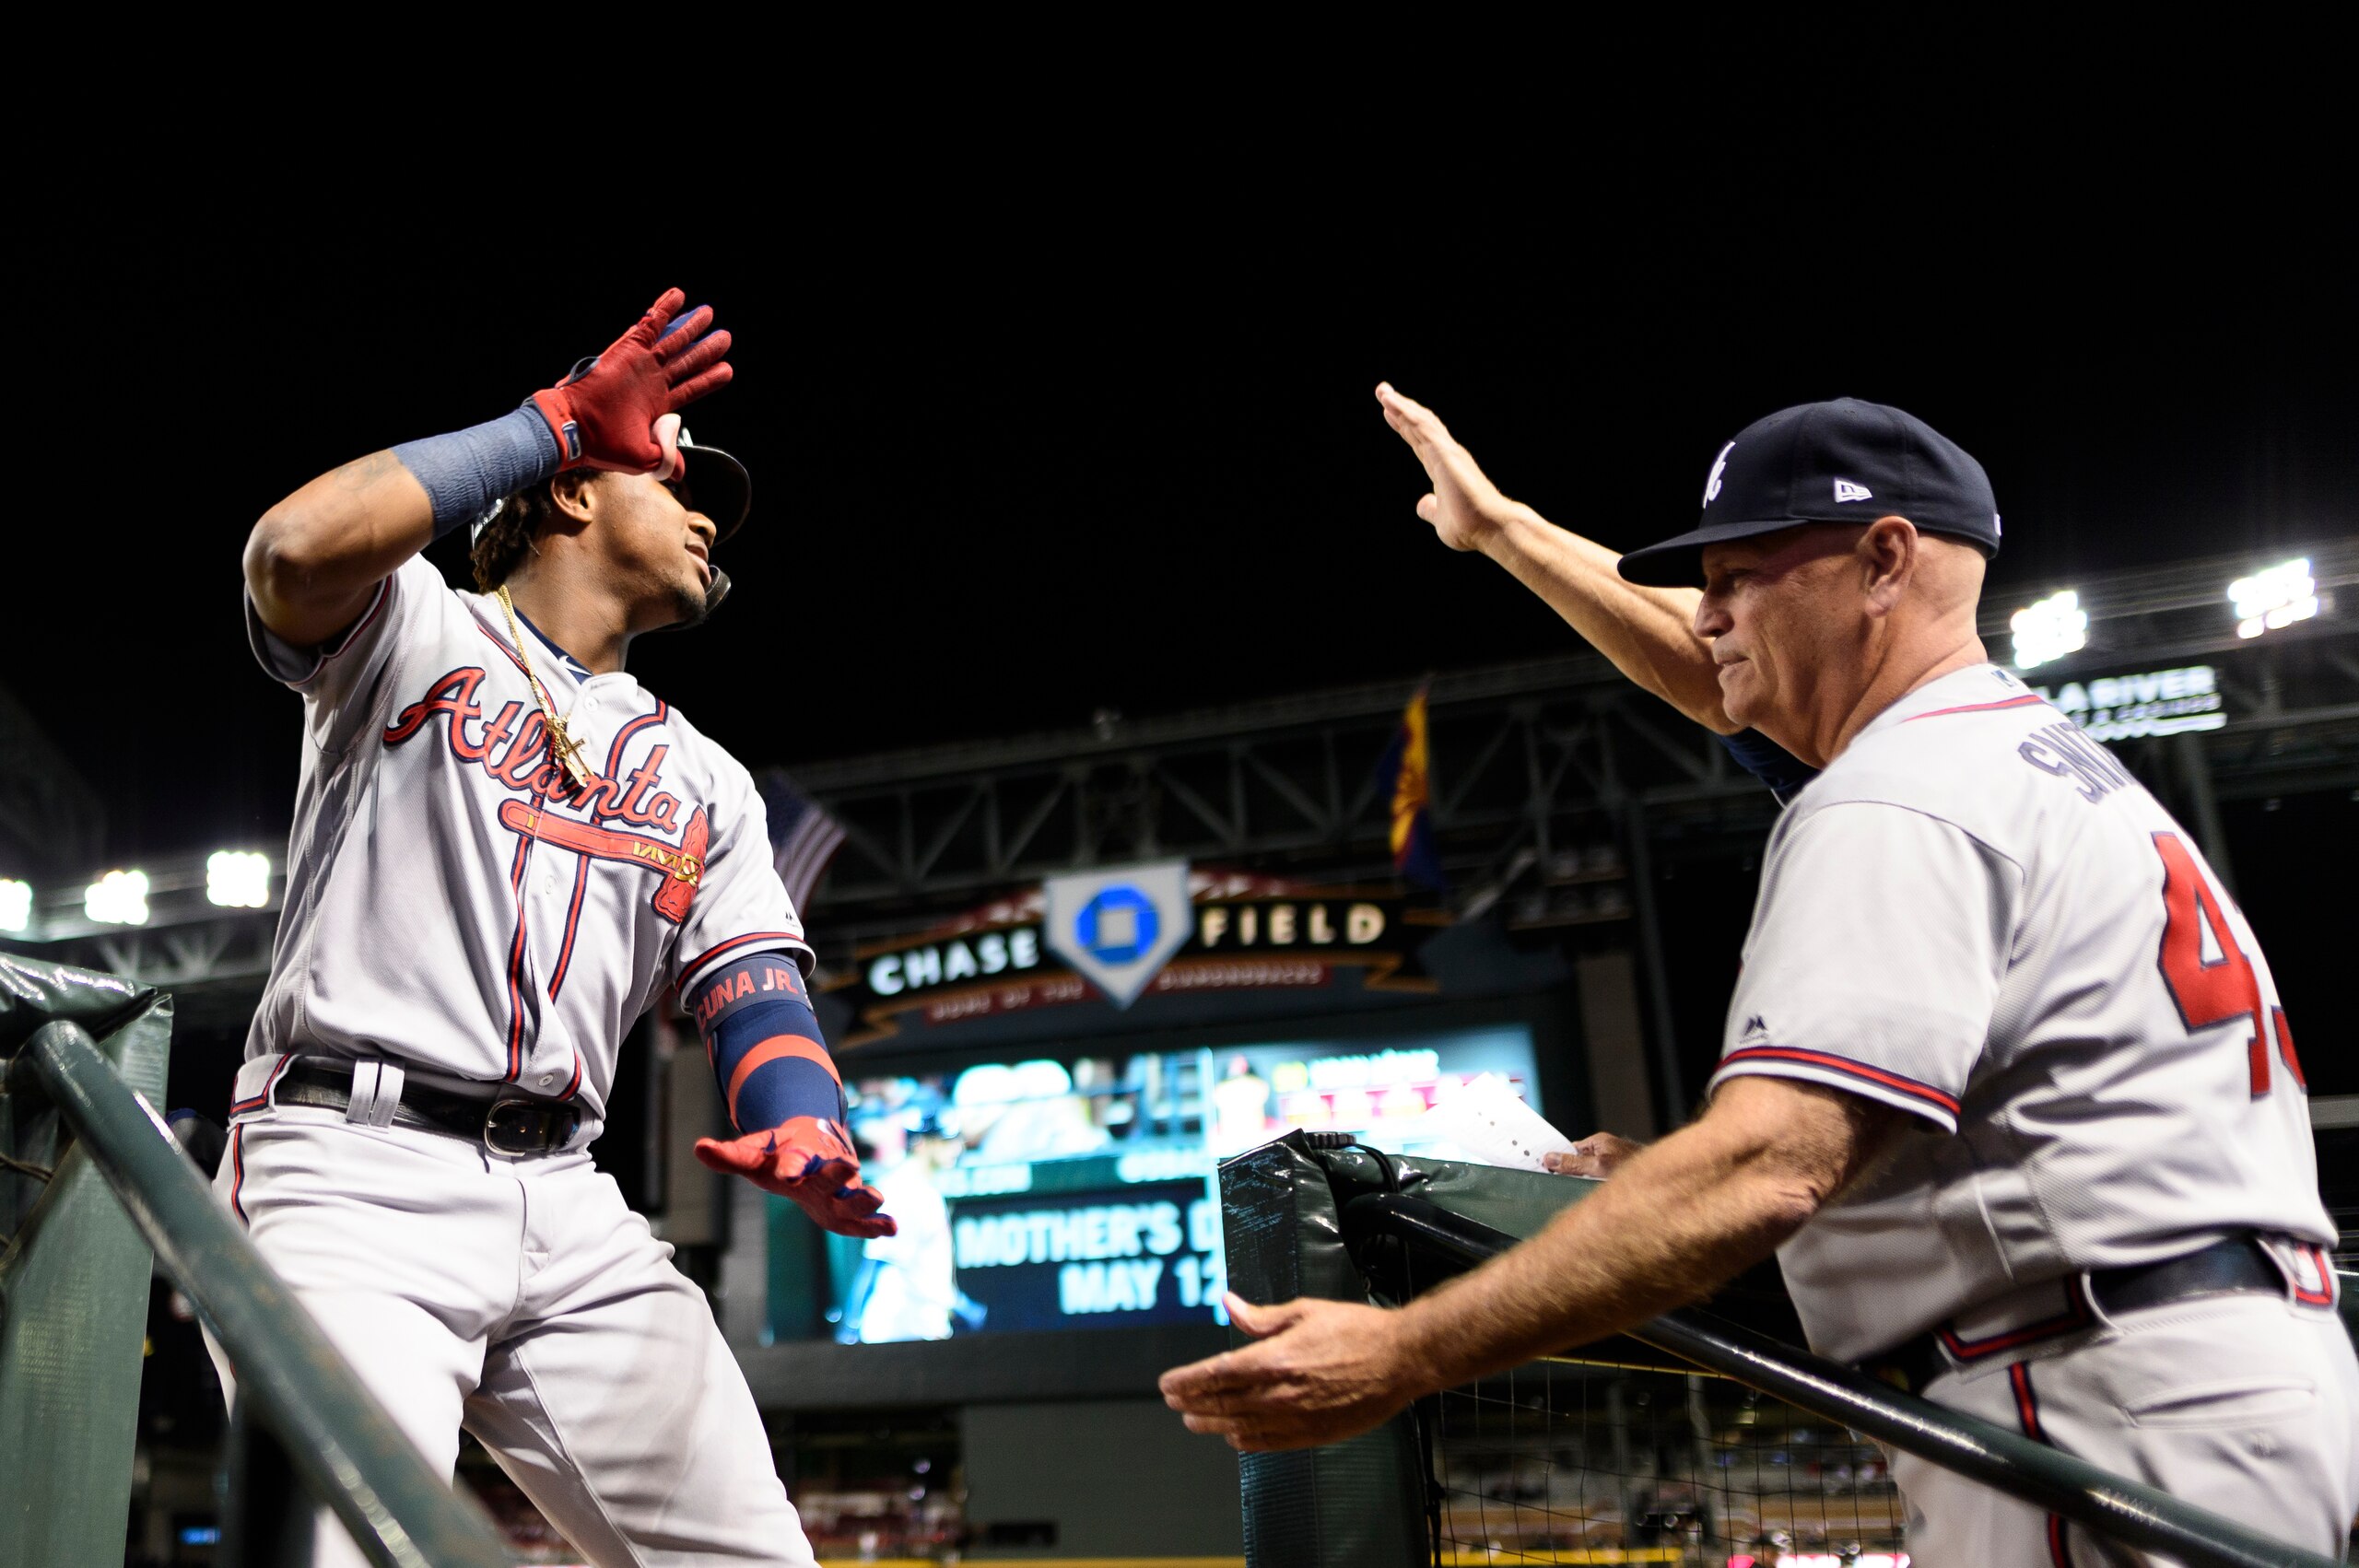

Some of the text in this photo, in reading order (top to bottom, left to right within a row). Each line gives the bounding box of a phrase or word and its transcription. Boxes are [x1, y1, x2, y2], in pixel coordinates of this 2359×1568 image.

[2087, 664, 2216, 710] RIVER
[382, 666, 681, 834] Atlanta
[868, 902, 1386, 996] CHASE FIELD
[2150, 831, 2307, 1103] 4
[956, 1200, 1183, 1270] MOTHER'S
[1060, 1258, 1163, 1315] MAY
